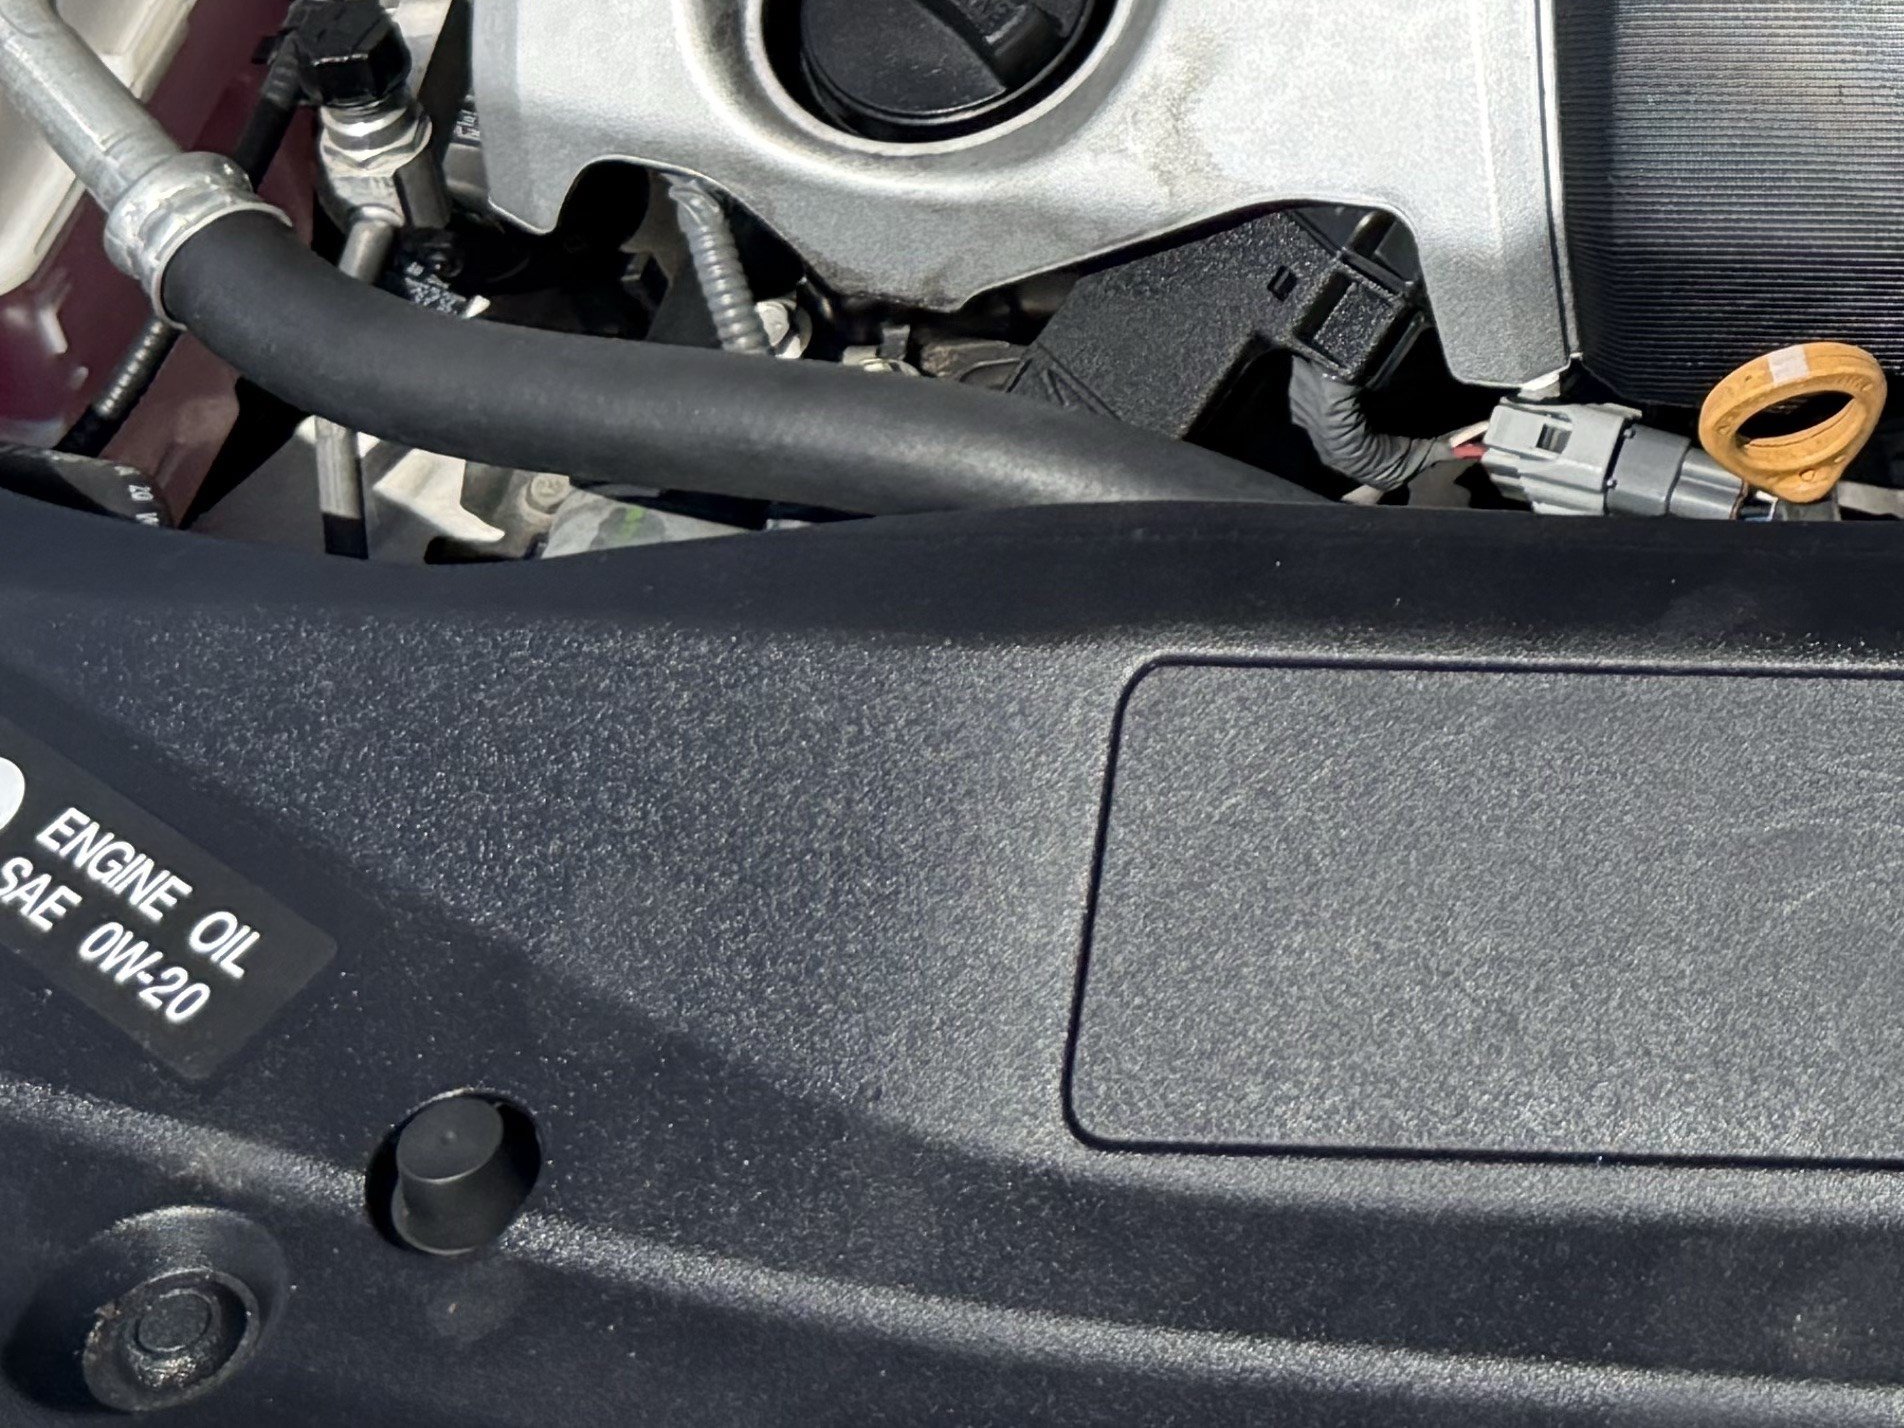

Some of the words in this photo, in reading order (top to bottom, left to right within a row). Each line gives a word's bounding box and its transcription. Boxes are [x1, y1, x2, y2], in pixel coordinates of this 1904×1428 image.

[0, 856, 82, 932] SAE
[78, 921, 212, 1024] 0W-20
[36, 806, 193, 923] ENGINE
[188, 909, 261, 980] OIL
